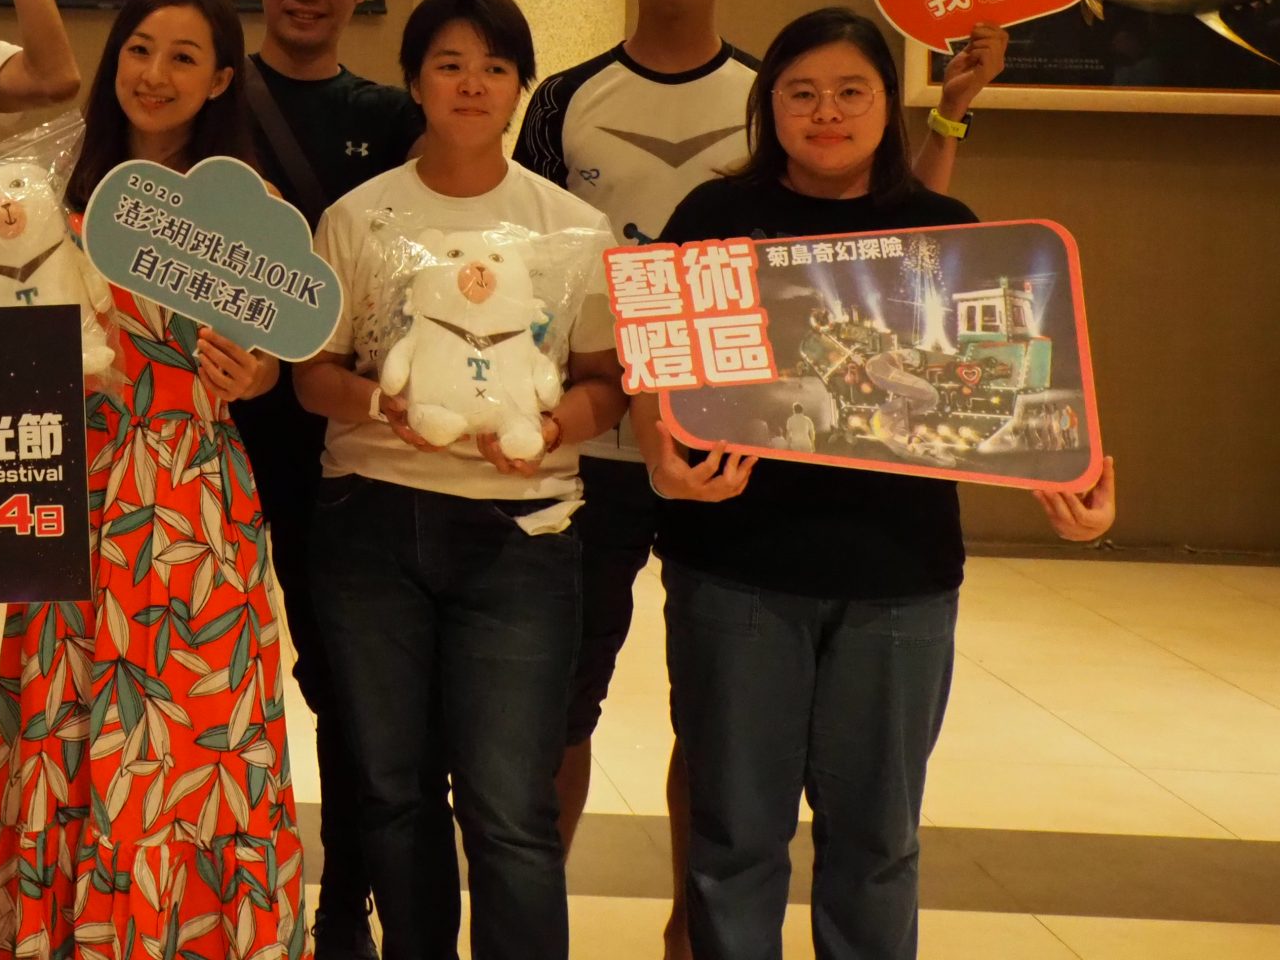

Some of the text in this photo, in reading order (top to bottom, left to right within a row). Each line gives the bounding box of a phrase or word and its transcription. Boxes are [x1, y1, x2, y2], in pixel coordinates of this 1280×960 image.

[128, 174, 183, 207] 2020
[114, 194, 325, 308] 澎湖跳島101K
[128, 245, 278, 331] 自行車活動
[608, 243, 756, 319] 藝術
[765, 236, 905, 268] 菊島奇幻探險
[619, 315, 773, 390] 燈區
